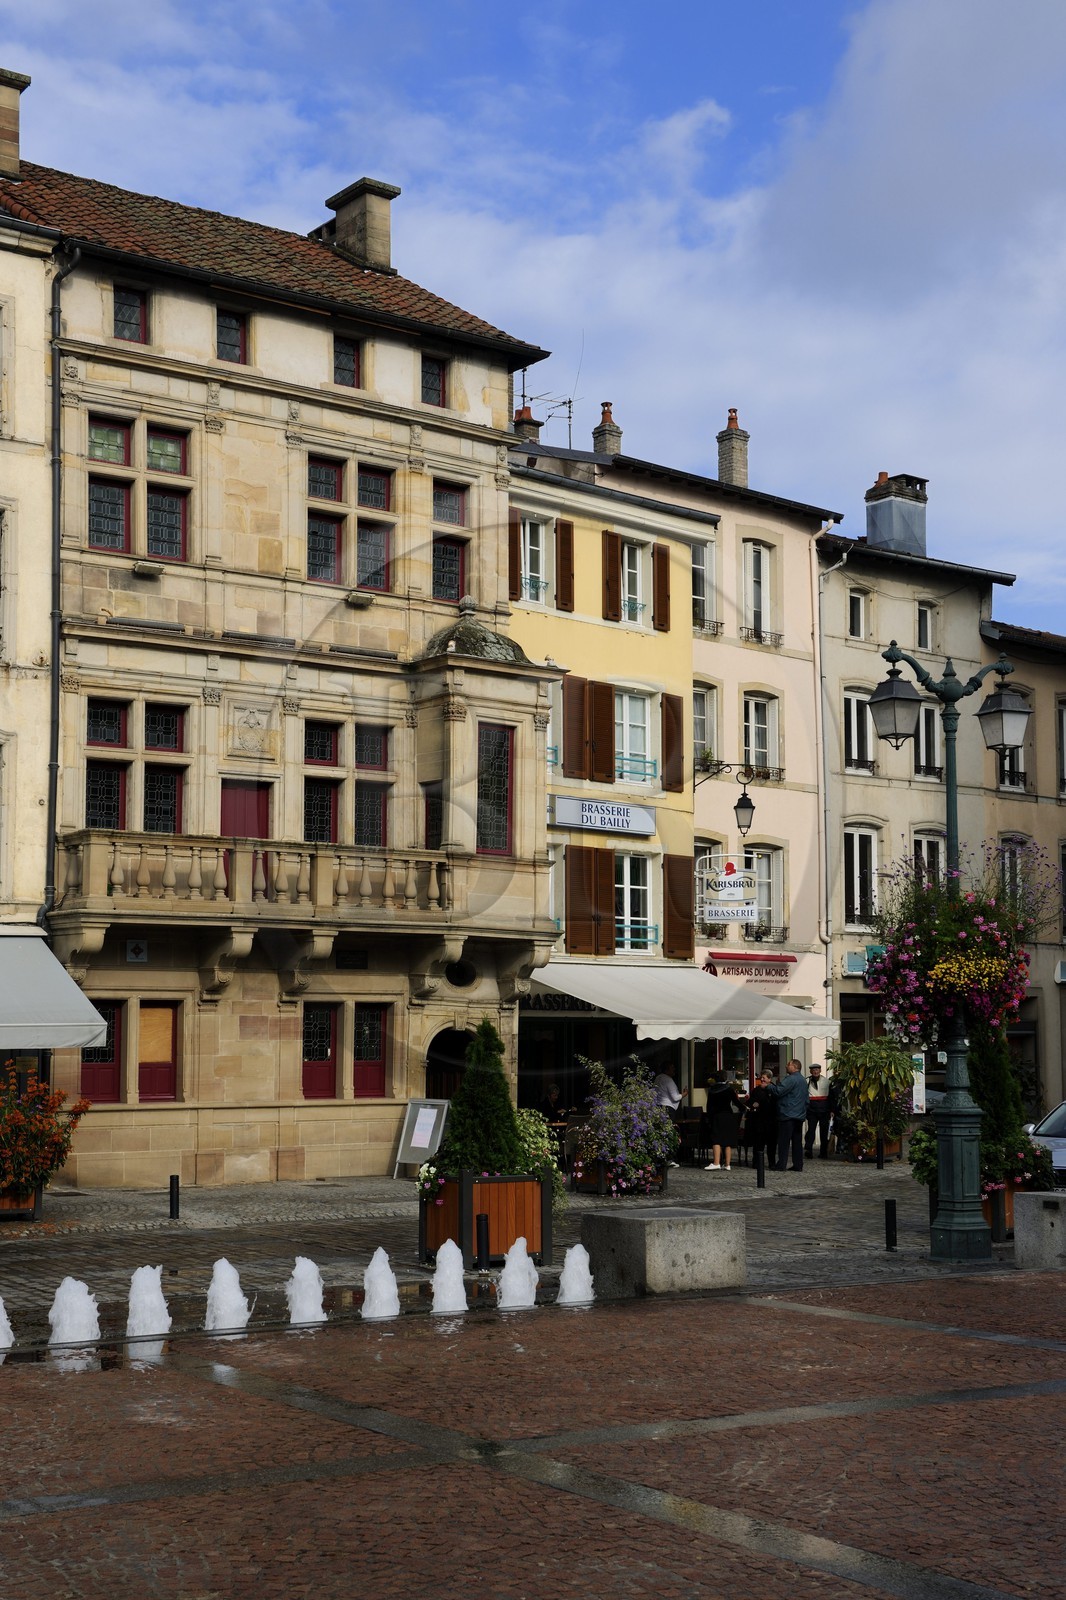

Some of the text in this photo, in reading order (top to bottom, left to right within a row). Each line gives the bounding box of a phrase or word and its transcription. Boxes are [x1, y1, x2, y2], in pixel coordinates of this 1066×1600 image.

[581, 803, 631, 817] BRASSERIE
[581, 814, 631, 828] DU BAILLY
[708, 909, 755, 918] BRASSERIE
[721, 967, 789, 977] ARTISANS DU MONDE
